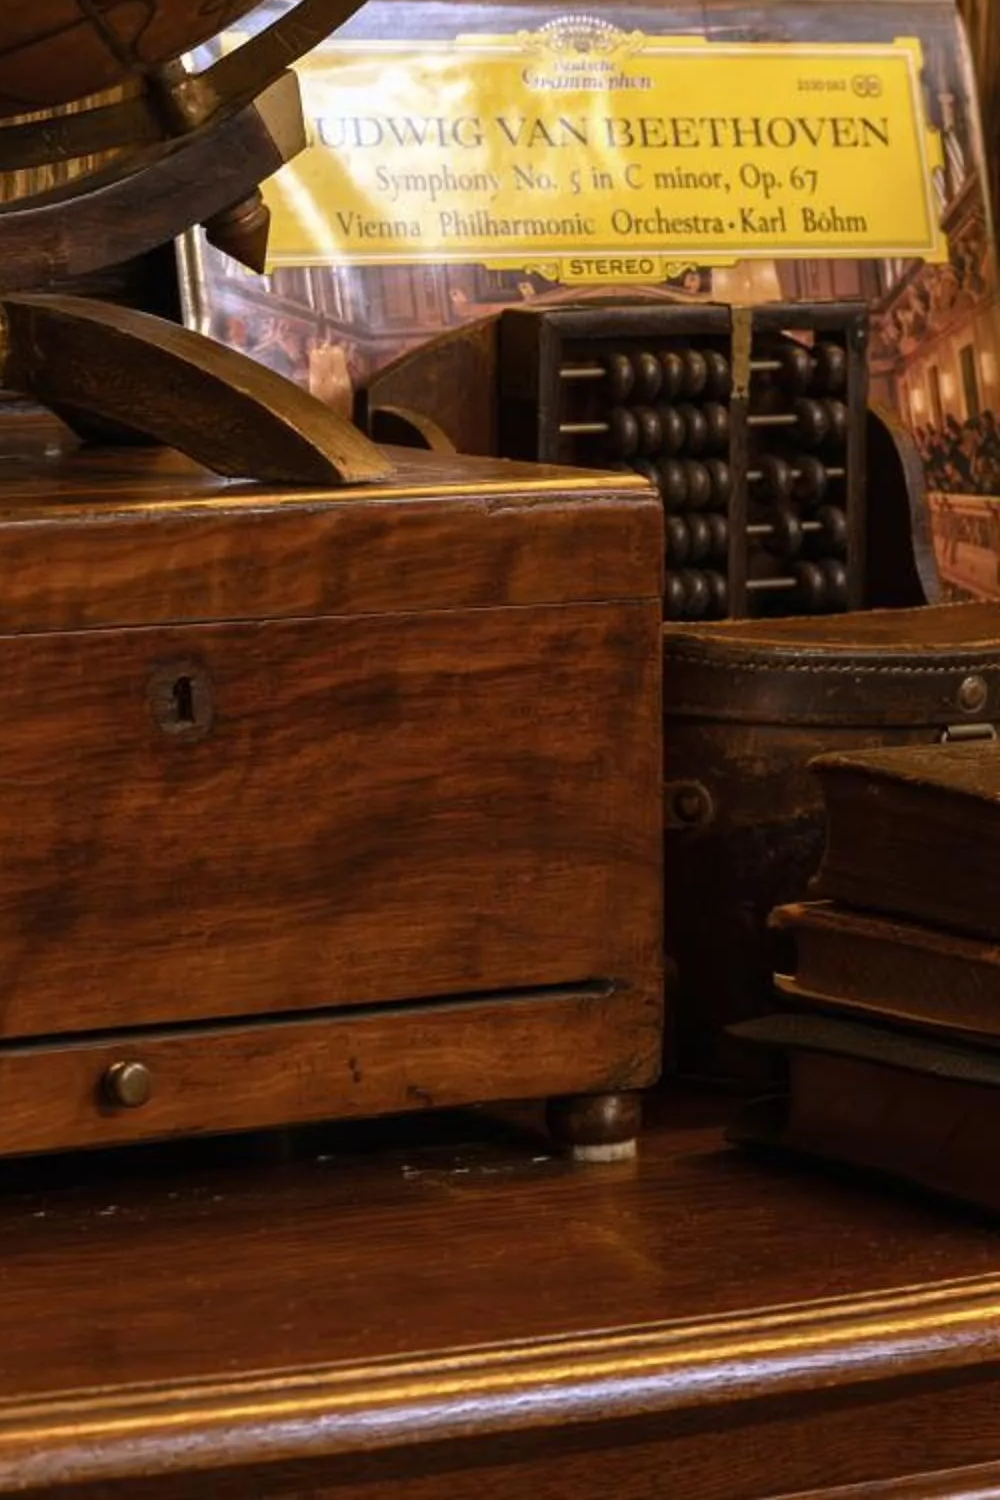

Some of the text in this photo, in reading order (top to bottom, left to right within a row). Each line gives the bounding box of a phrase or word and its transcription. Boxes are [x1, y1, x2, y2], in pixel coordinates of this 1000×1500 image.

[304, 116, 891, 150] UDWIG VAN BEETHOVEN
[376, 163, 819, 201] Symphony No. 5 in C minor, Op. 67
[335, 209, 421, 239] Vienna
[439, 209, 596, 238] Philharmonic
[569, 258, 655, 277] STEREO
